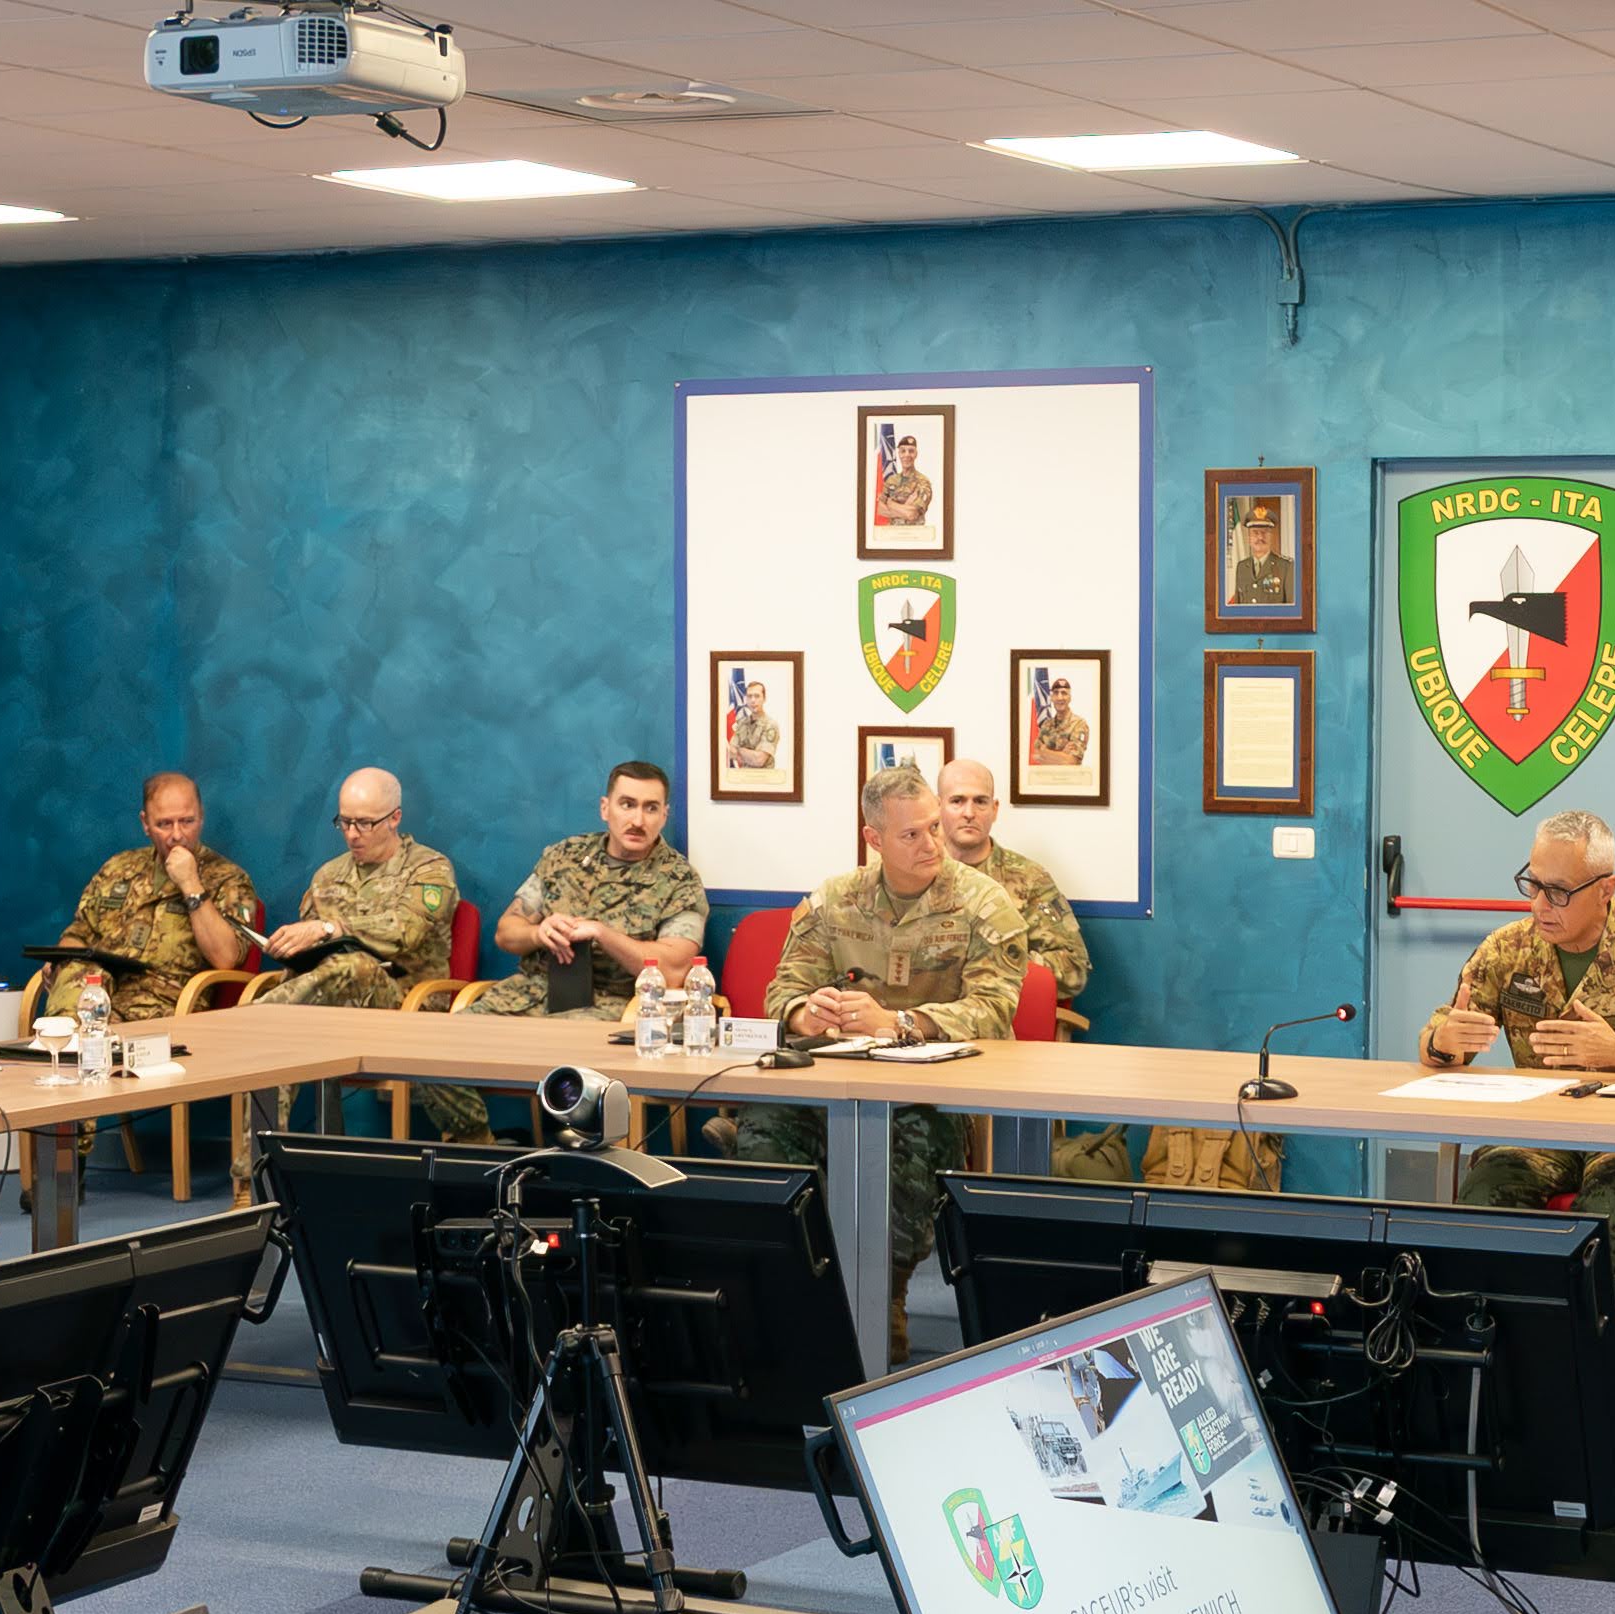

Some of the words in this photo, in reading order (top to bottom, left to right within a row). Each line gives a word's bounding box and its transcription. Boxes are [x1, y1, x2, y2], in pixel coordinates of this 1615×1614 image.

[232, 48, 257, 57] EPSON
[1431, 487, 1522, 524] NRDC
[1550, 487, 1604, 523] ITA
[871, 574, 909, 589] NRDC
[920, 576, 943, 589] ITA
[863, 642, 897, 694] UBIQUE
[919, 640, 953, 693] CELERE
[1409, 645, 1490, 769] UBIQUE
[1138, 1326, 1164, 1353] WE
[1151, 1343, 1181, 1382] ARE
[1161, 1360, 1205, 1409] READY
[1196, 1407, 1218, 1429] ALLIED
[1206, 1431, 1228, 1455] FORCE
[1143, 1565, 1178, 1602] visit
